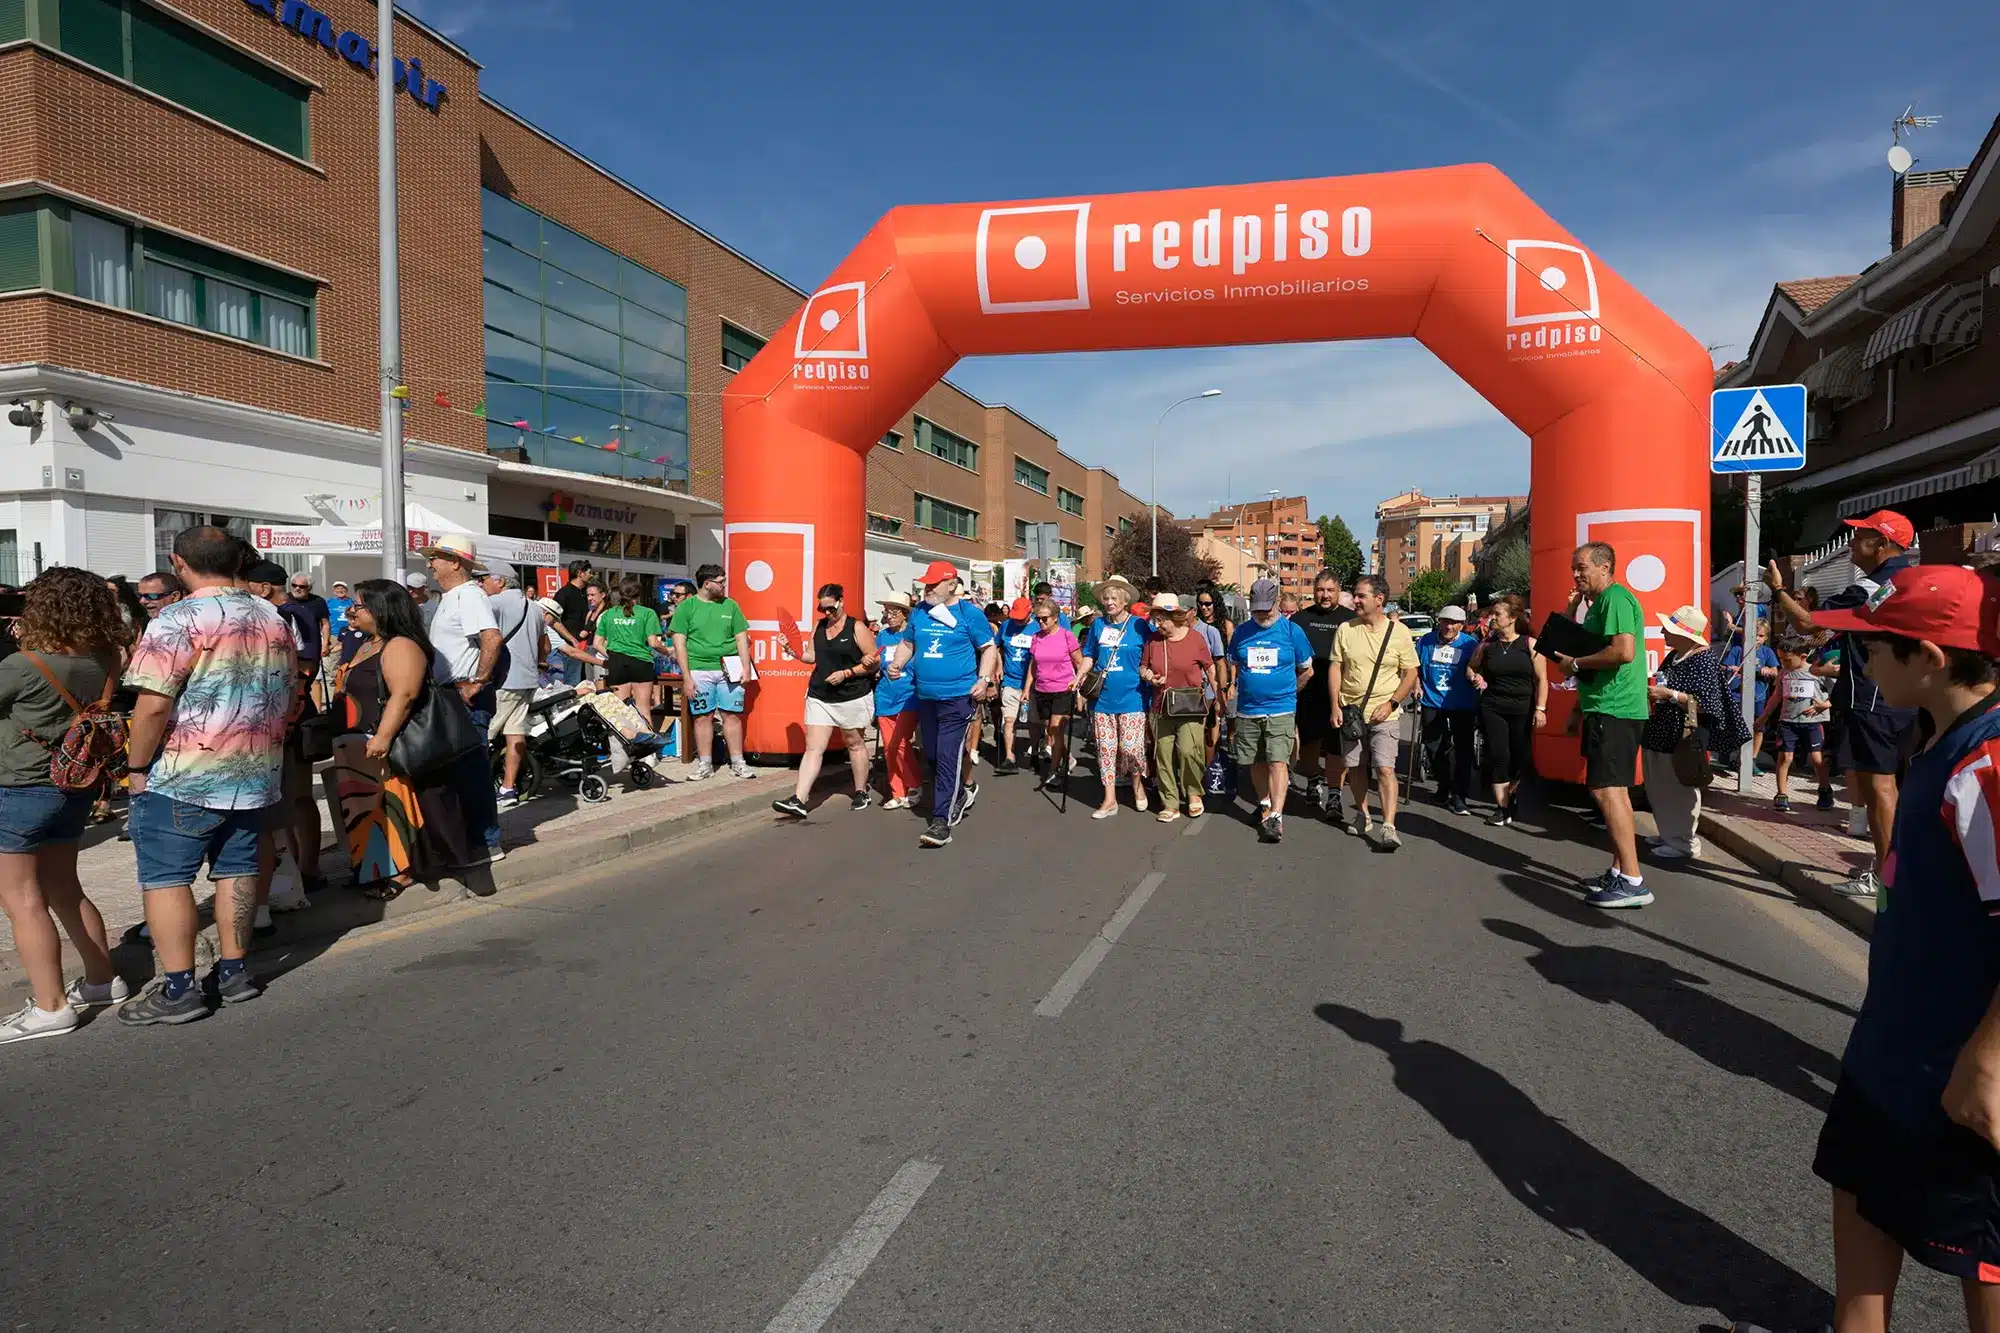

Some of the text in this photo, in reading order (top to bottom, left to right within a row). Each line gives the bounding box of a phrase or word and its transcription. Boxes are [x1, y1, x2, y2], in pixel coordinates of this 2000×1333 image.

[245, 0, 446, 109] mair
[1113, 204, 1371, 274] redpiso
[1116, 277, 1369, 304] Servicios Inmobiliarios
[1506, 324, 1600, 351] redpiso
[1546, 348, 1600, 359] Inmobiliarios
[793, 361, 869, 382] redpiso
[574, 504, 638, 525] amavir
[361, 529, 383, 539] JUVEN
[272, 535, 310, 547] ALCORCÓN
[524, 543, 556, 553] JUVENTUD
[512, 551, 556, 563] Y DIVERSIDAD
[613, 618, 636, 626] STAFF
[758, 668, 811, 677] mobiliarios
[692, 699, 707, 711] 23
